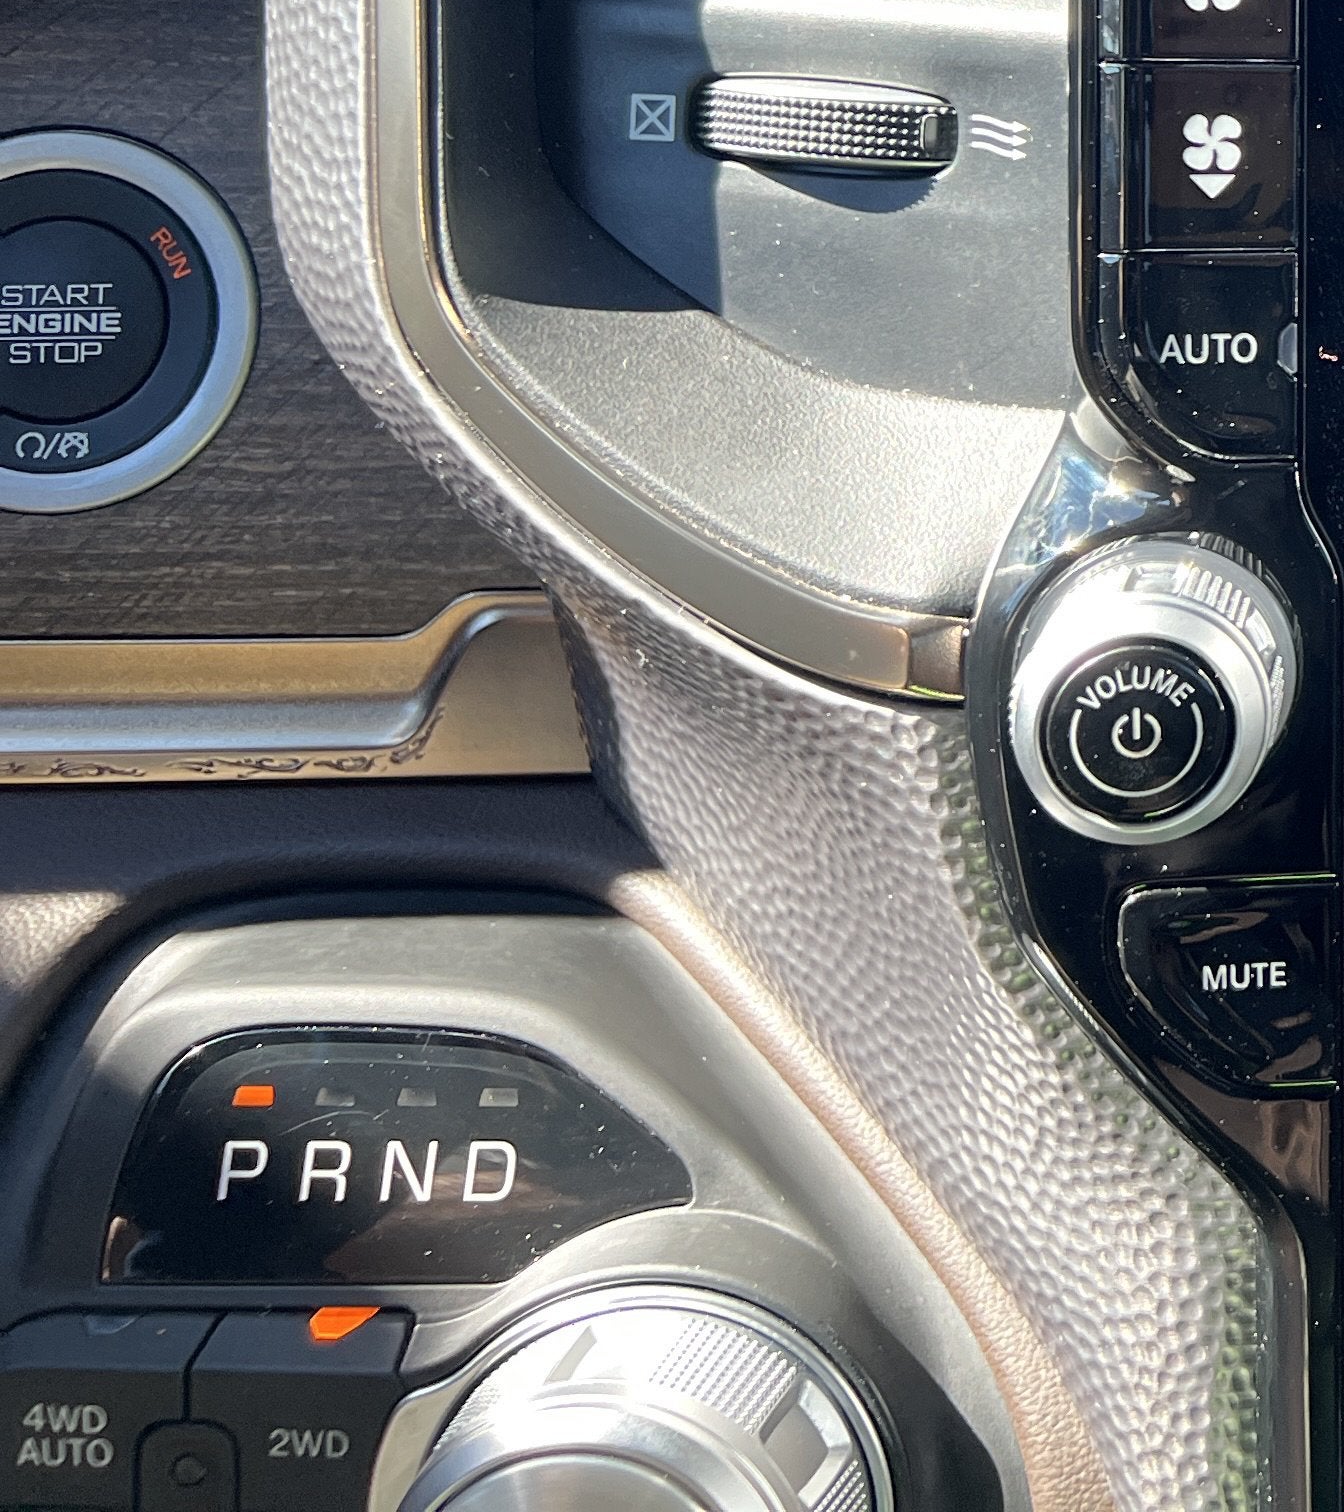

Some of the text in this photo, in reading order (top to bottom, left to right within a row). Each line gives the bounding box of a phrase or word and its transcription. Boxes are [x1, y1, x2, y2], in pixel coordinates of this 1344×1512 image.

[150, 226, 192, 280] RUN
[1, 283, 113, 306] START
[0, 312, 122, 334] ENGINE
[9, 342, 102, 364] STOP
[1159, 332, 1258, 364] AUTO
[1076, 665, 1195, 710] VOLUME
[1201, 961, 1287, 991] MUTE
[216, 1139, 518, 1202] P R N D
[22, 1402, 108, 1435] 4WD
[16, 1436, 114, 1468] AUTO
[267, 1428, 350, 1460] 2WD
